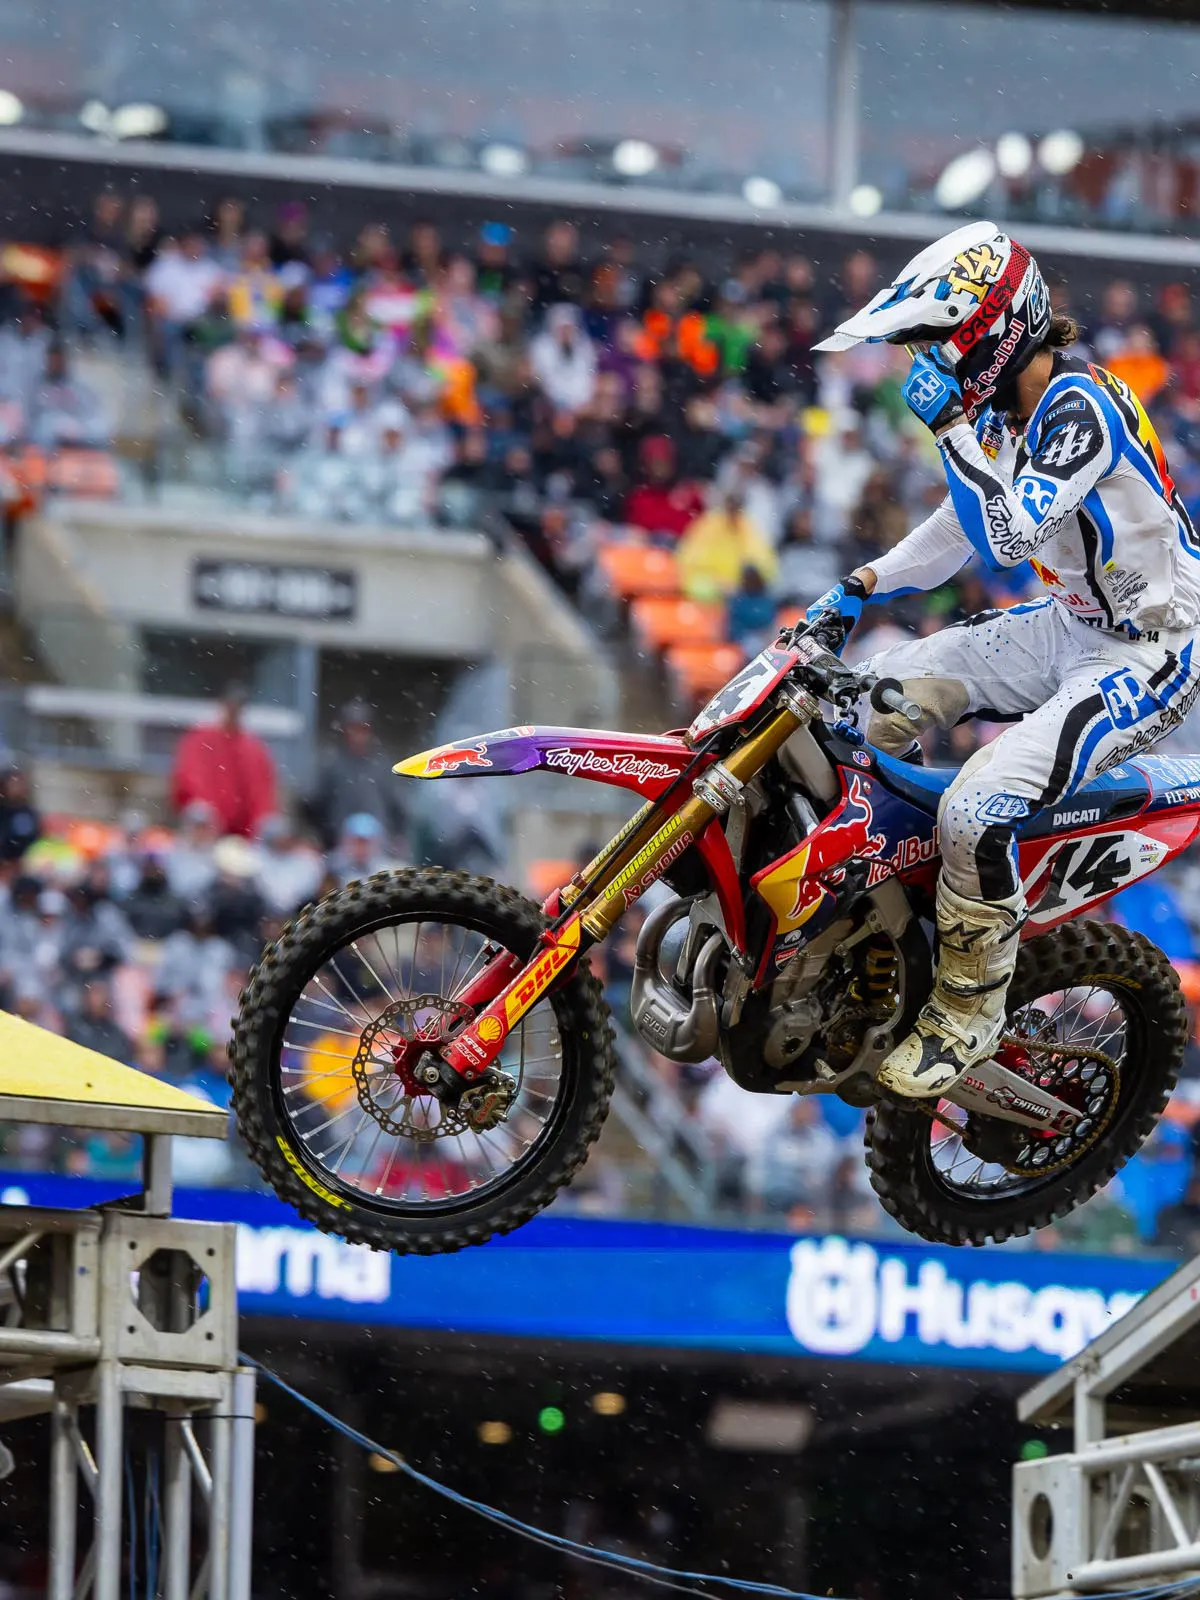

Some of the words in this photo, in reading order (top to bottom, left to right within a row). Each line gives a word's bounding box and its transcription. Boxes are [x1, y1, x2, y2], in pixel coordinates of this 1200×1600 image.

[947, 243, 1004, 304] 14
[959, 276, 1016, 345] OAKLEY
[977, 349, 1010, 386] Red
[998, 318, 1027, 357] Bull
[546, 748, 585, 775] Troy
[582, 751, 612, 773] Lee
[611, 754, 681, 784] Designs
[903, 824, 941, 868] Bul
[1053, 808, 1100, 826] DUCATI
[604, 814, 682, 900] connection
[641, 830, 694, 886] SHOWA
[1029, 834, 1132, 916] 14
[515, 948, 570, 1008] DHL
